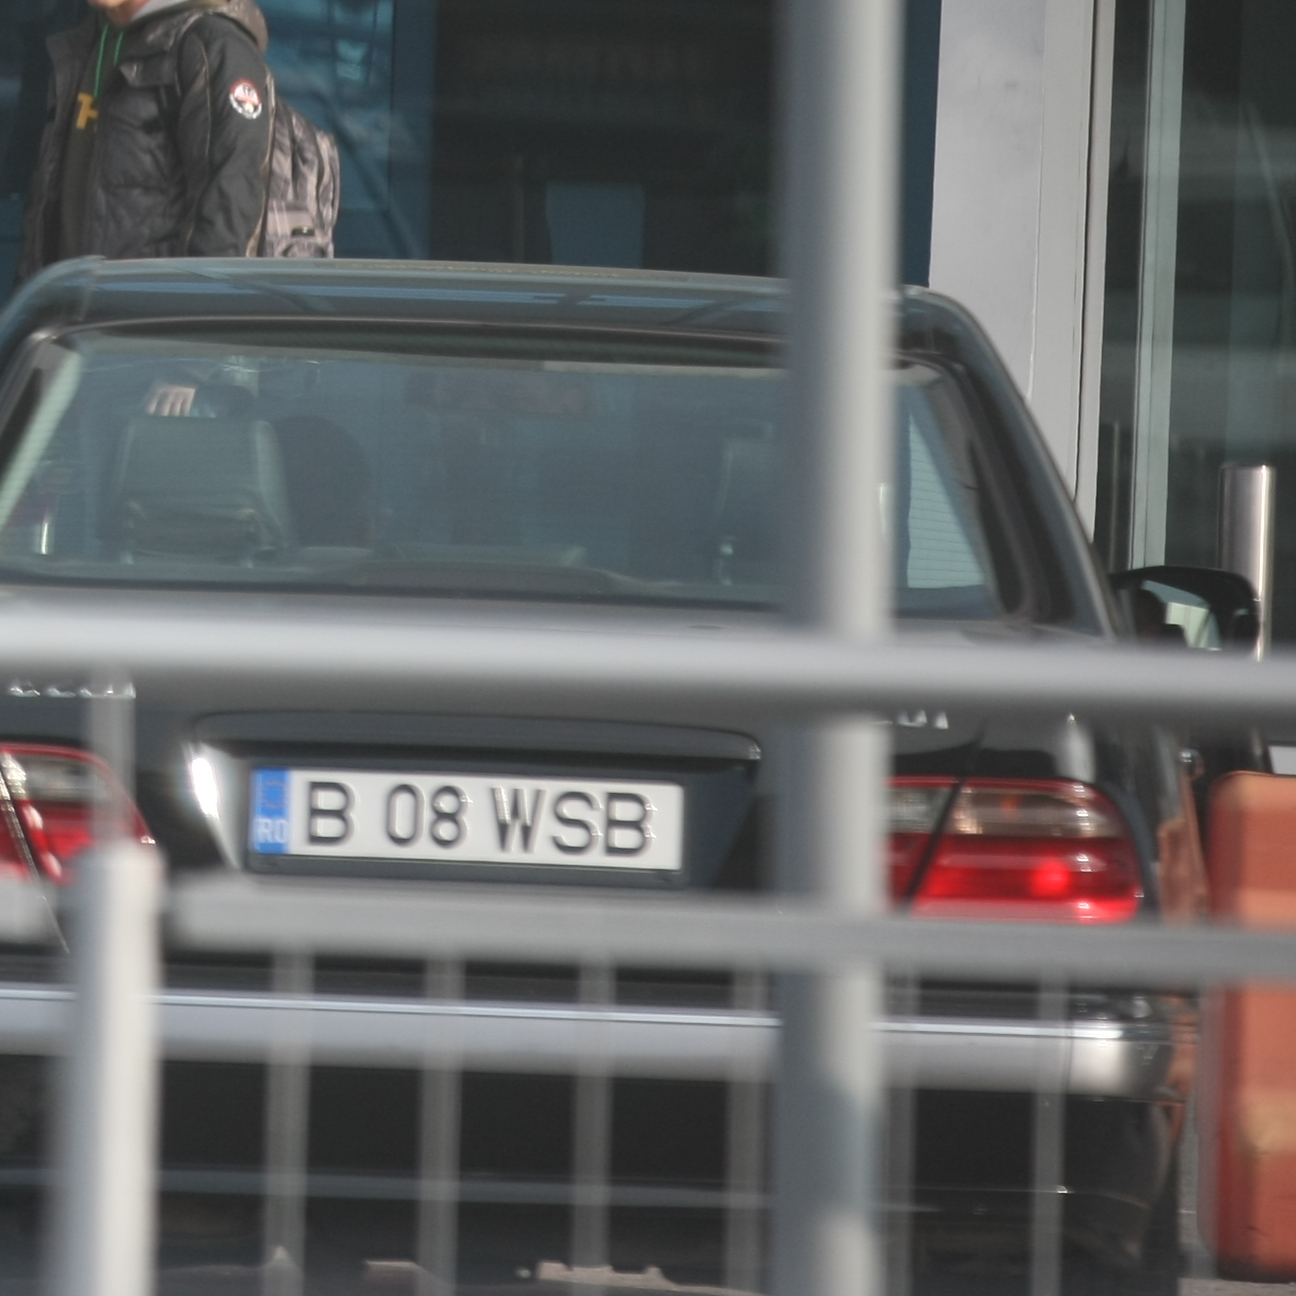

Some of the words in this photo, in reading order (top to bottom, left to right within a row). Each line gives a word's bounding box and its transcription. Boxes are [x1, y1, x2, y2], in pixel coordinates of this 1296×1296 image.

[255, 817, 289, 844] RO
[308, 780, 357, 846] B
[386, 783, 472, 849] 08
[491, 786, 658, 857] WSB
